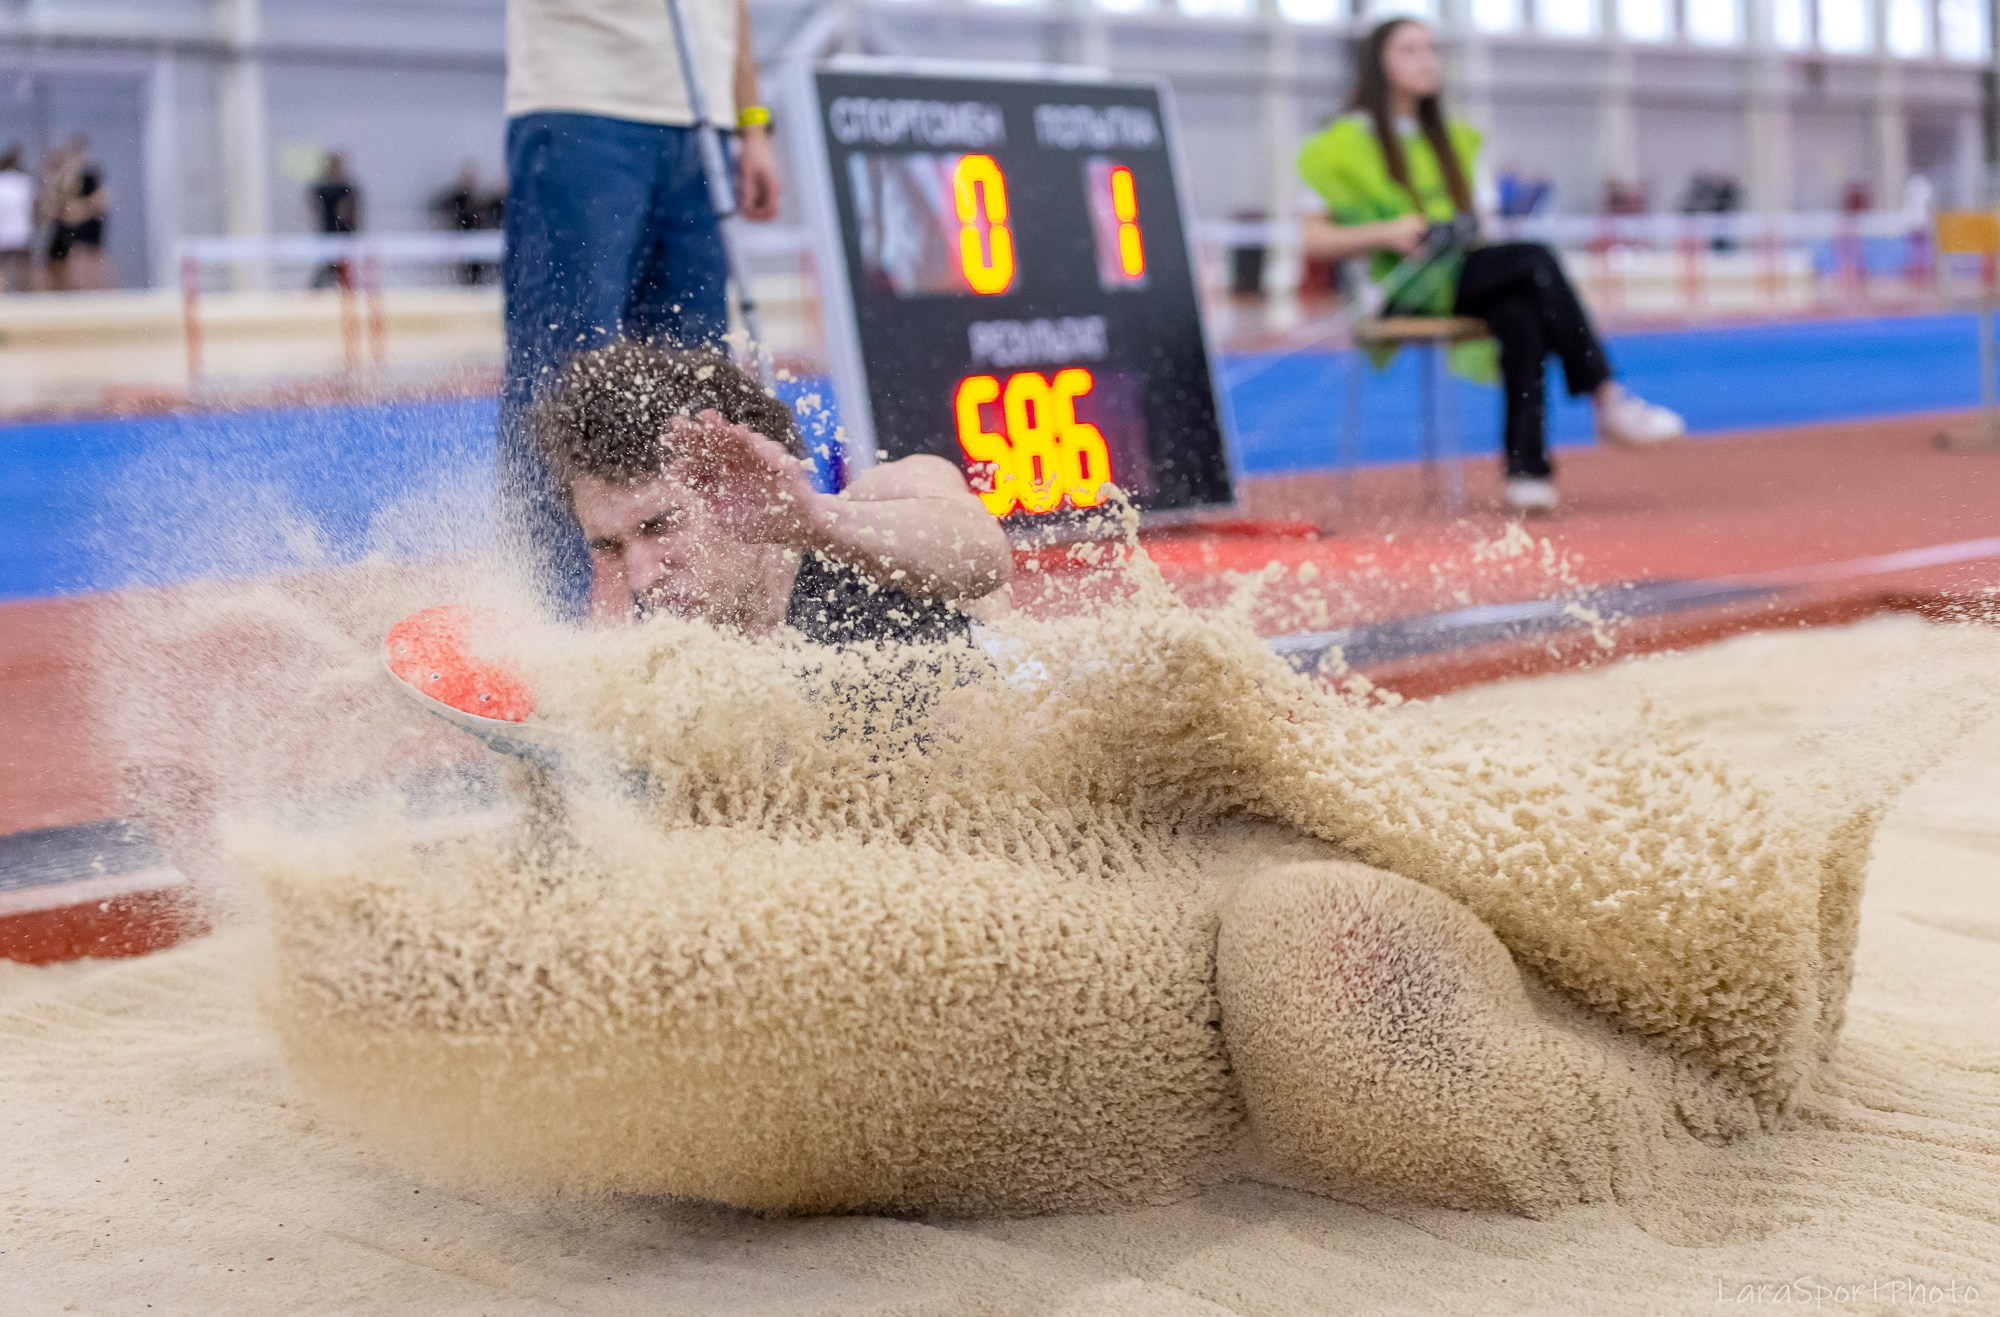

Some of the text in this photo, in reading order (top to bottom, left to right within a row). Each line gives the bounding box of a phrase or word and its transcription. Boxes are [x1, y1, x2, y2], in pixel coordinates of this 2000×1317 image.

[953, 153, 1015, 295] 0
[1111, 165, 1145, 280] 1
[954, 367, 1112, 517] 586
